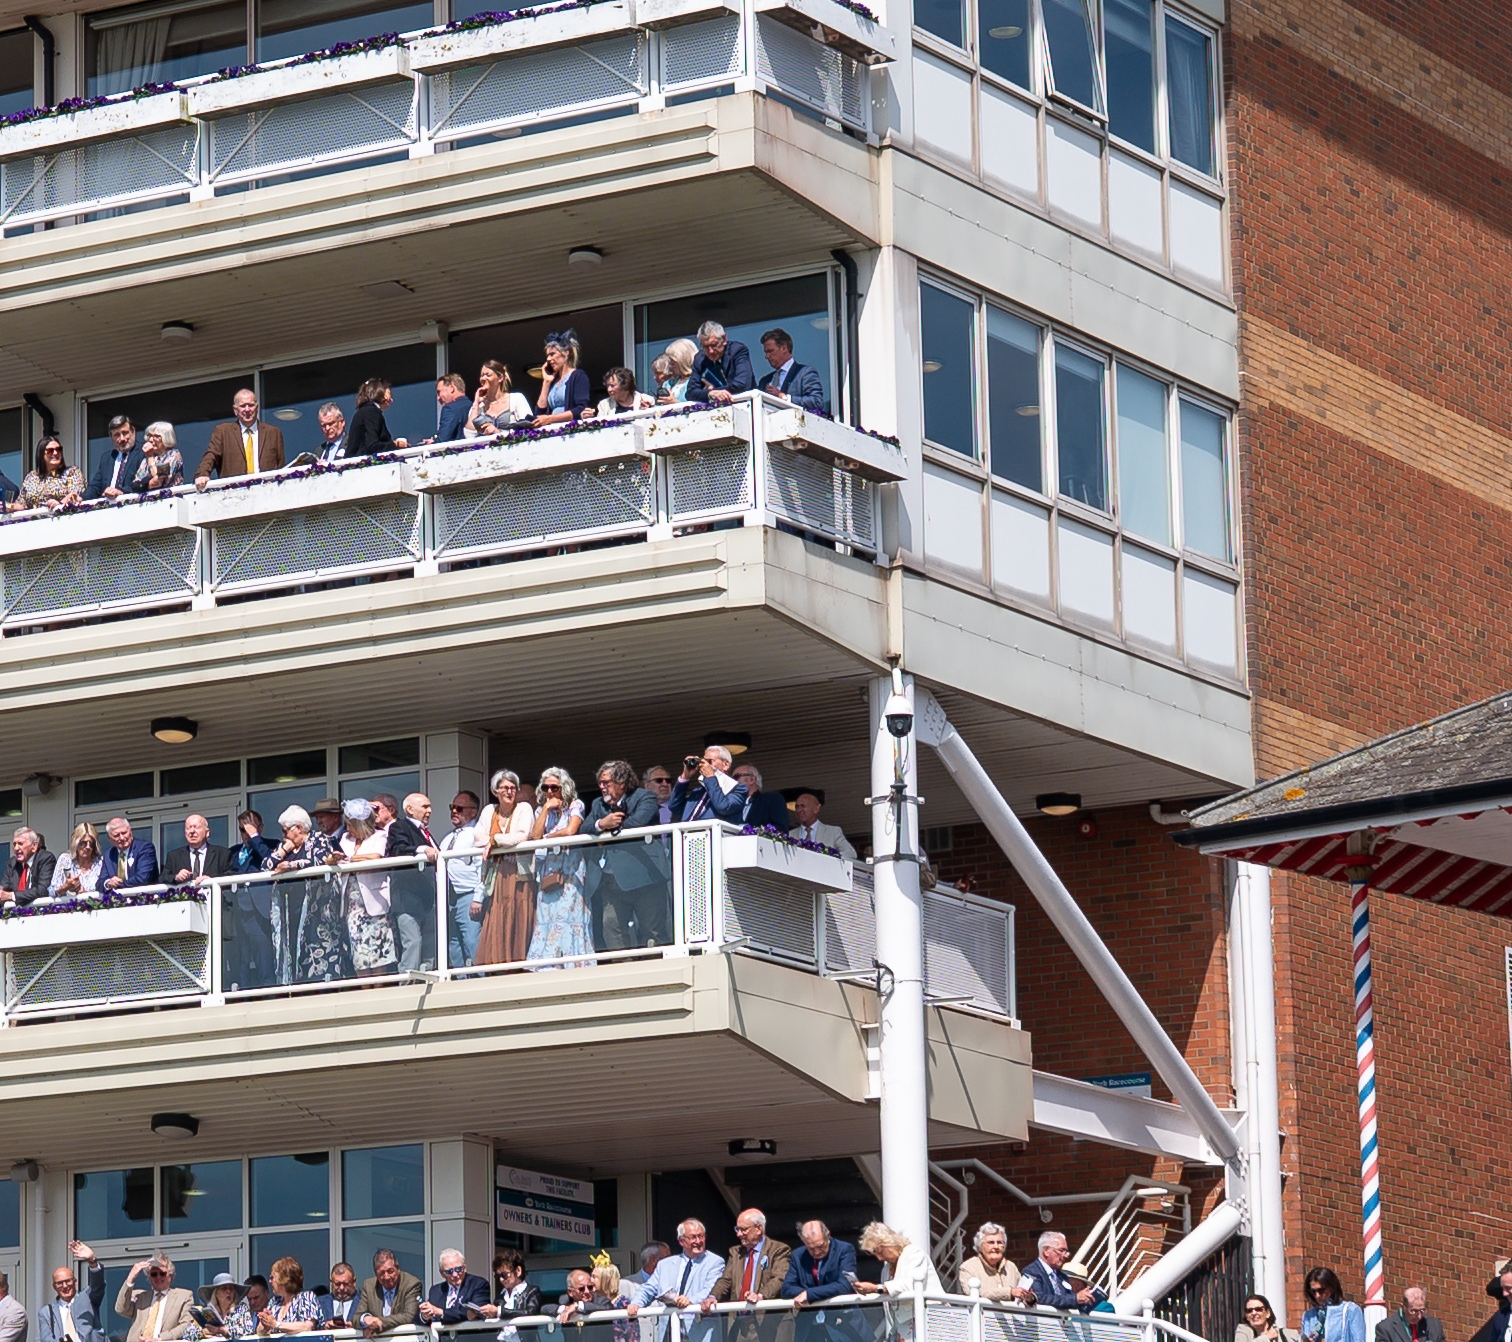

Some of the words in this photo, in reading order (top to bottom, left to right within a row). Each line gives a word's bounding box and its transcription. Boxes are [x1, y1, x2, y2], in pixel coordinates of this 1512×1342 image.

[561, 1179, 580, 1190] SUPPORT
[503, 1208, 532, 1225] OWNERS
[534, 1214, 539, 1226] &
[541, 1215, 572, 1232] TRAINERS
[574, 1221, 591, 1236] CLUB
